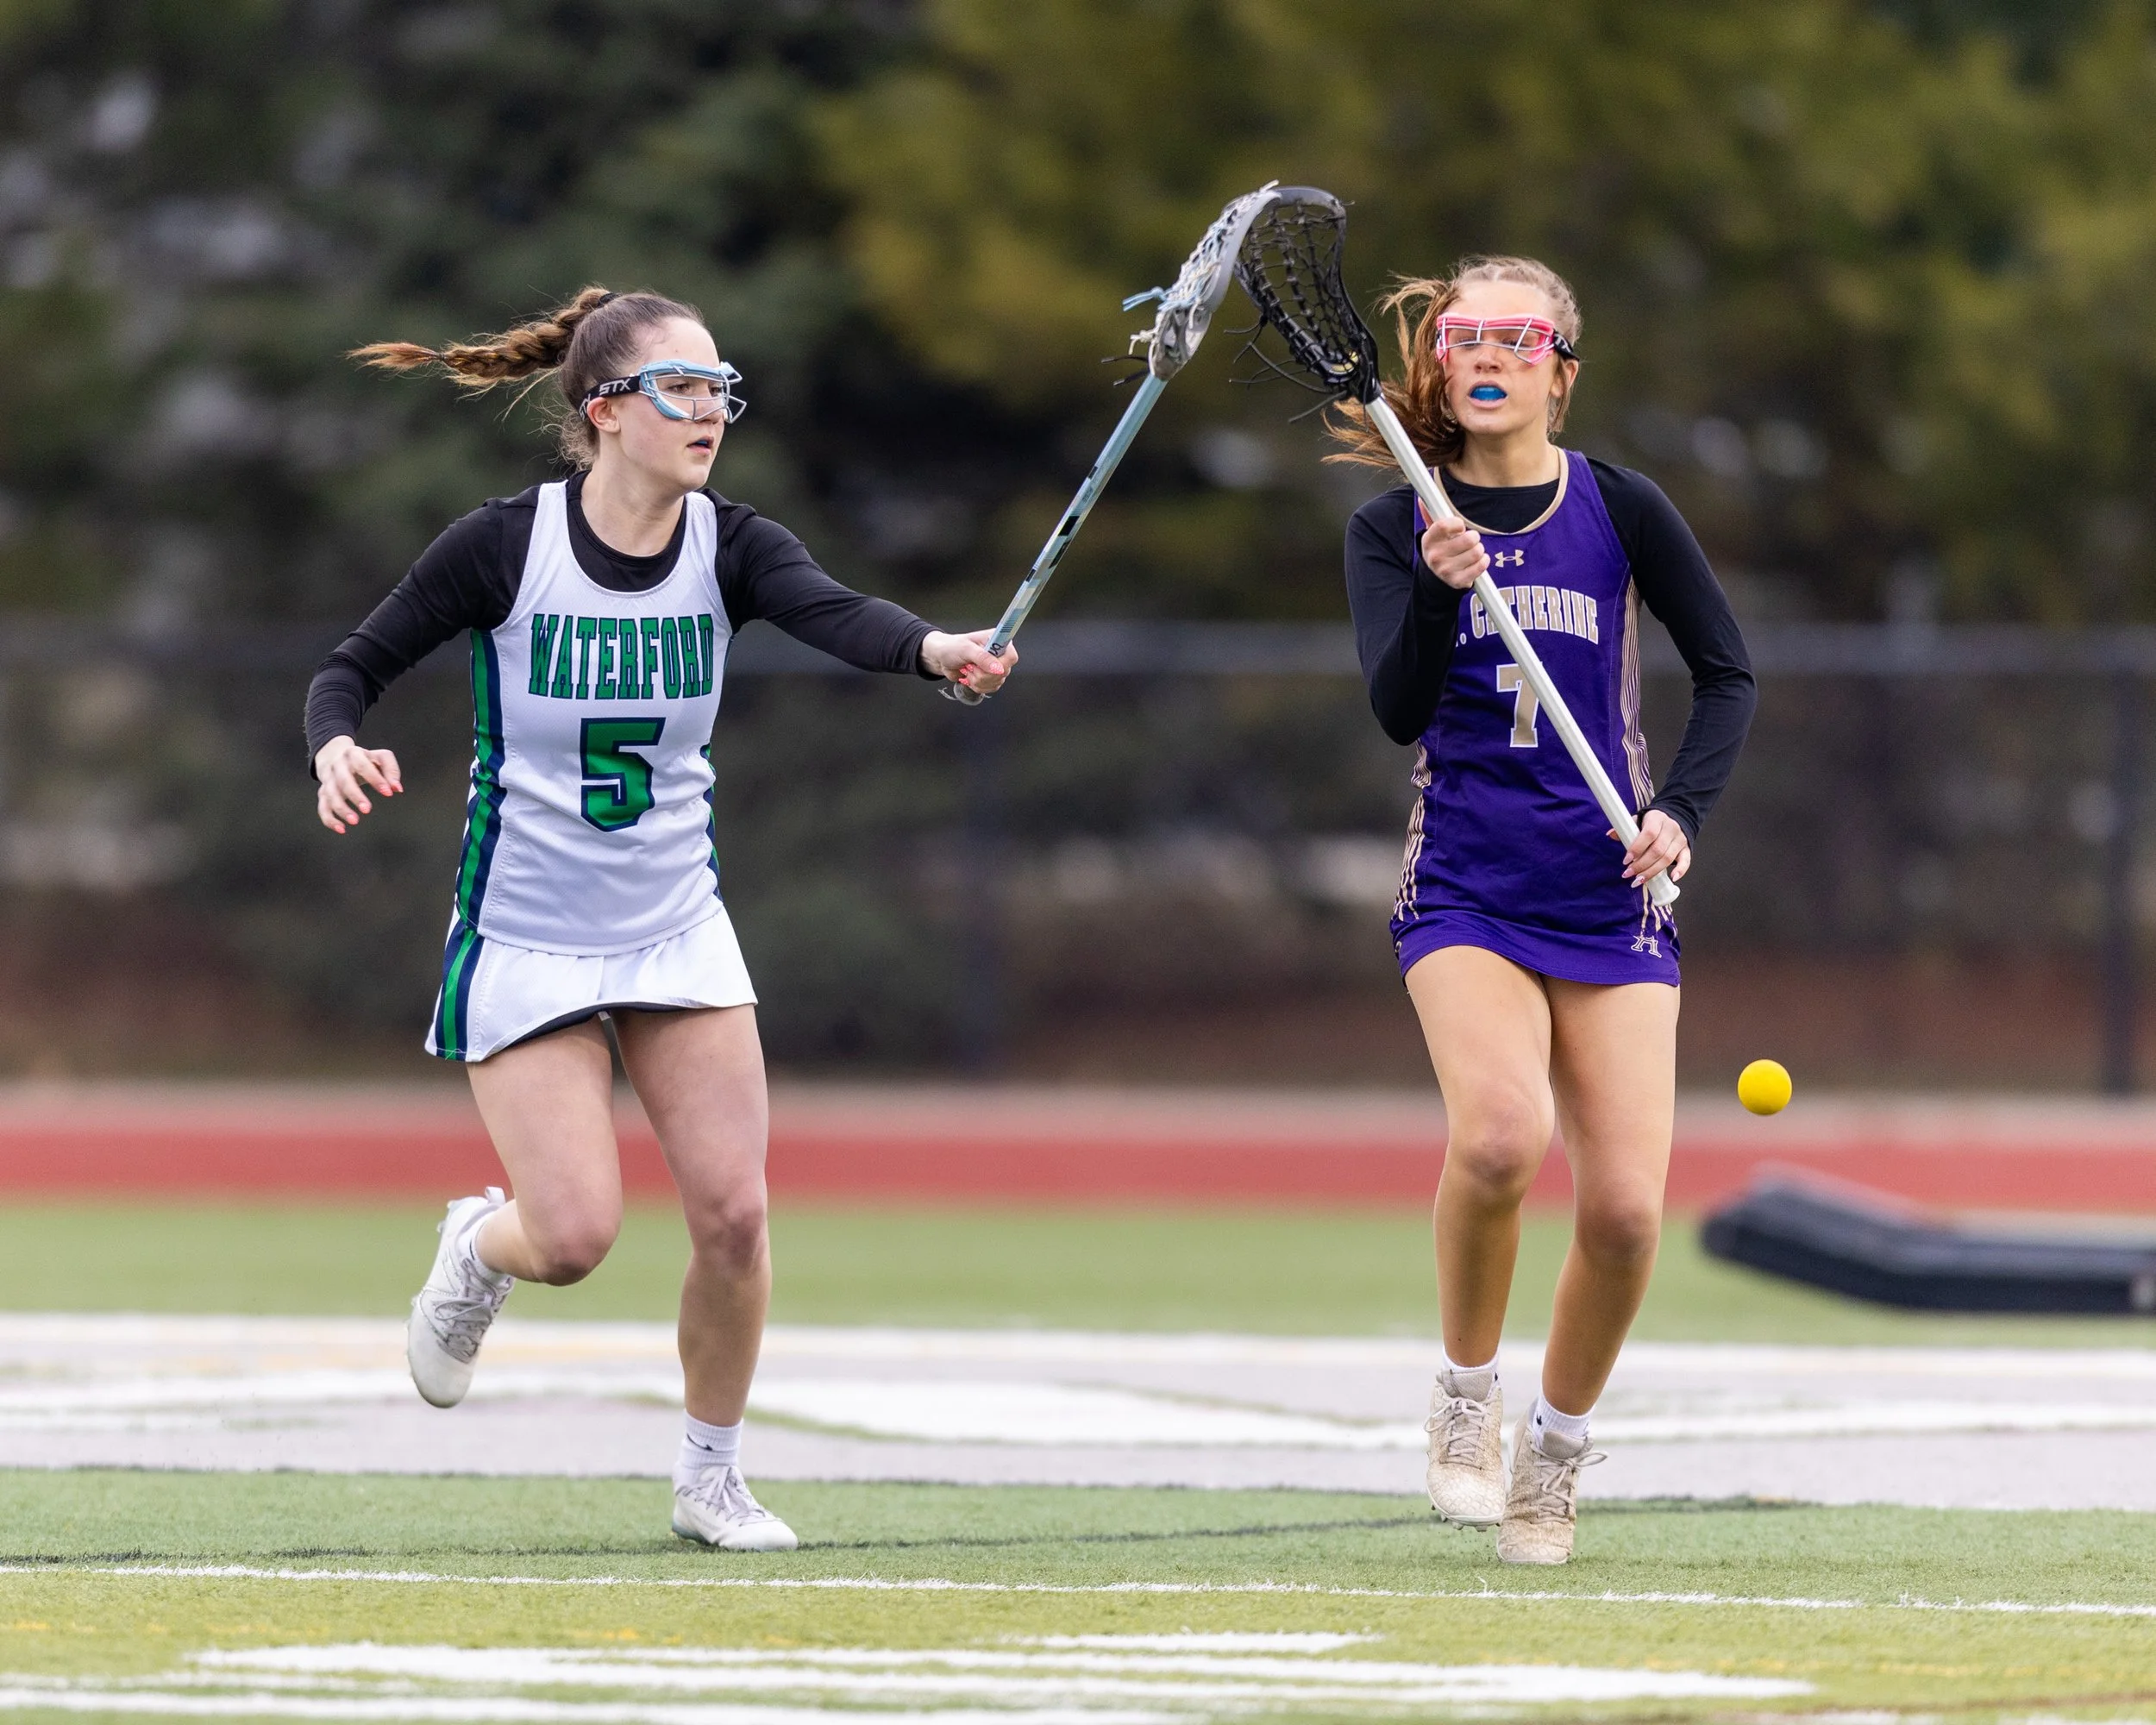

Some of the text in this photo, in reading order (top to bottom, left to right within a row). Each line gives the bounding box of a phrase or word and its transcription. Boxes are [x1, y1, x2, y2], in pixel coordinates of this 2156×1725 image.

[599, 378, 631, 397] STX
[528, 613, 714, 699] WATERFORD
[1496, 662, 1543, 748] 7
[580, 717, 667, 832] 5
